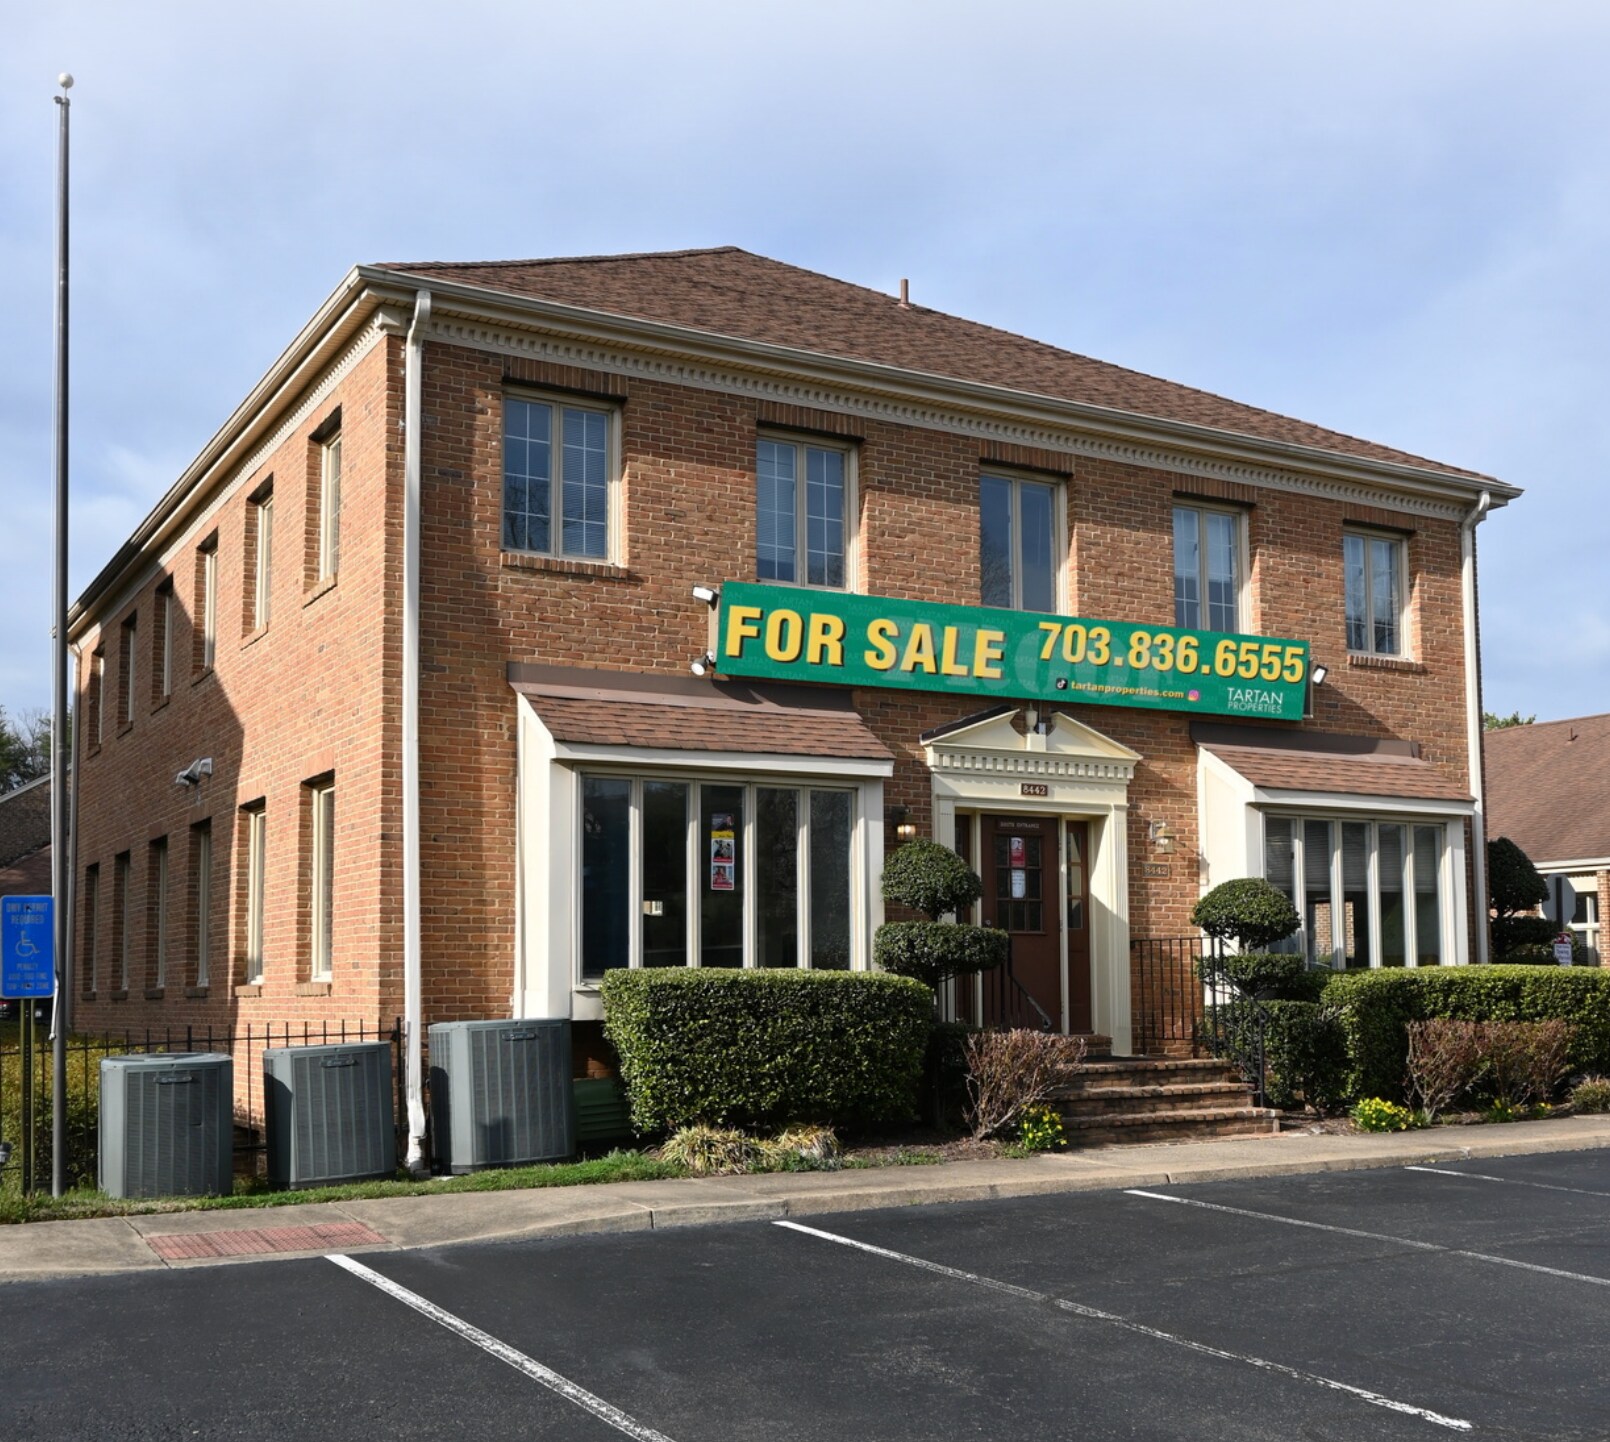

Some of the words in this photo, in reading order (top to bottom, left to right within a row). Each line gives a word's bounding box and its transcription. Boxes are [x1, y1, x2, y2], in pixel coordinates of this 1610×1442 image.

[725, 605, 845, 666] FOR
[863, 618, 1005, 679] SALE
[1038, 621, 1305, 683] 703.836.6555
[1071, 680, 1184, 699] tartanproperties.com
[1227, 687, 1284, 705] TARTAN
[1227, 701, 1282, 714] PROPERTIES
[1022, 784, 1047, 795] 8442
[1144, 865, 1168, 875] 8442
